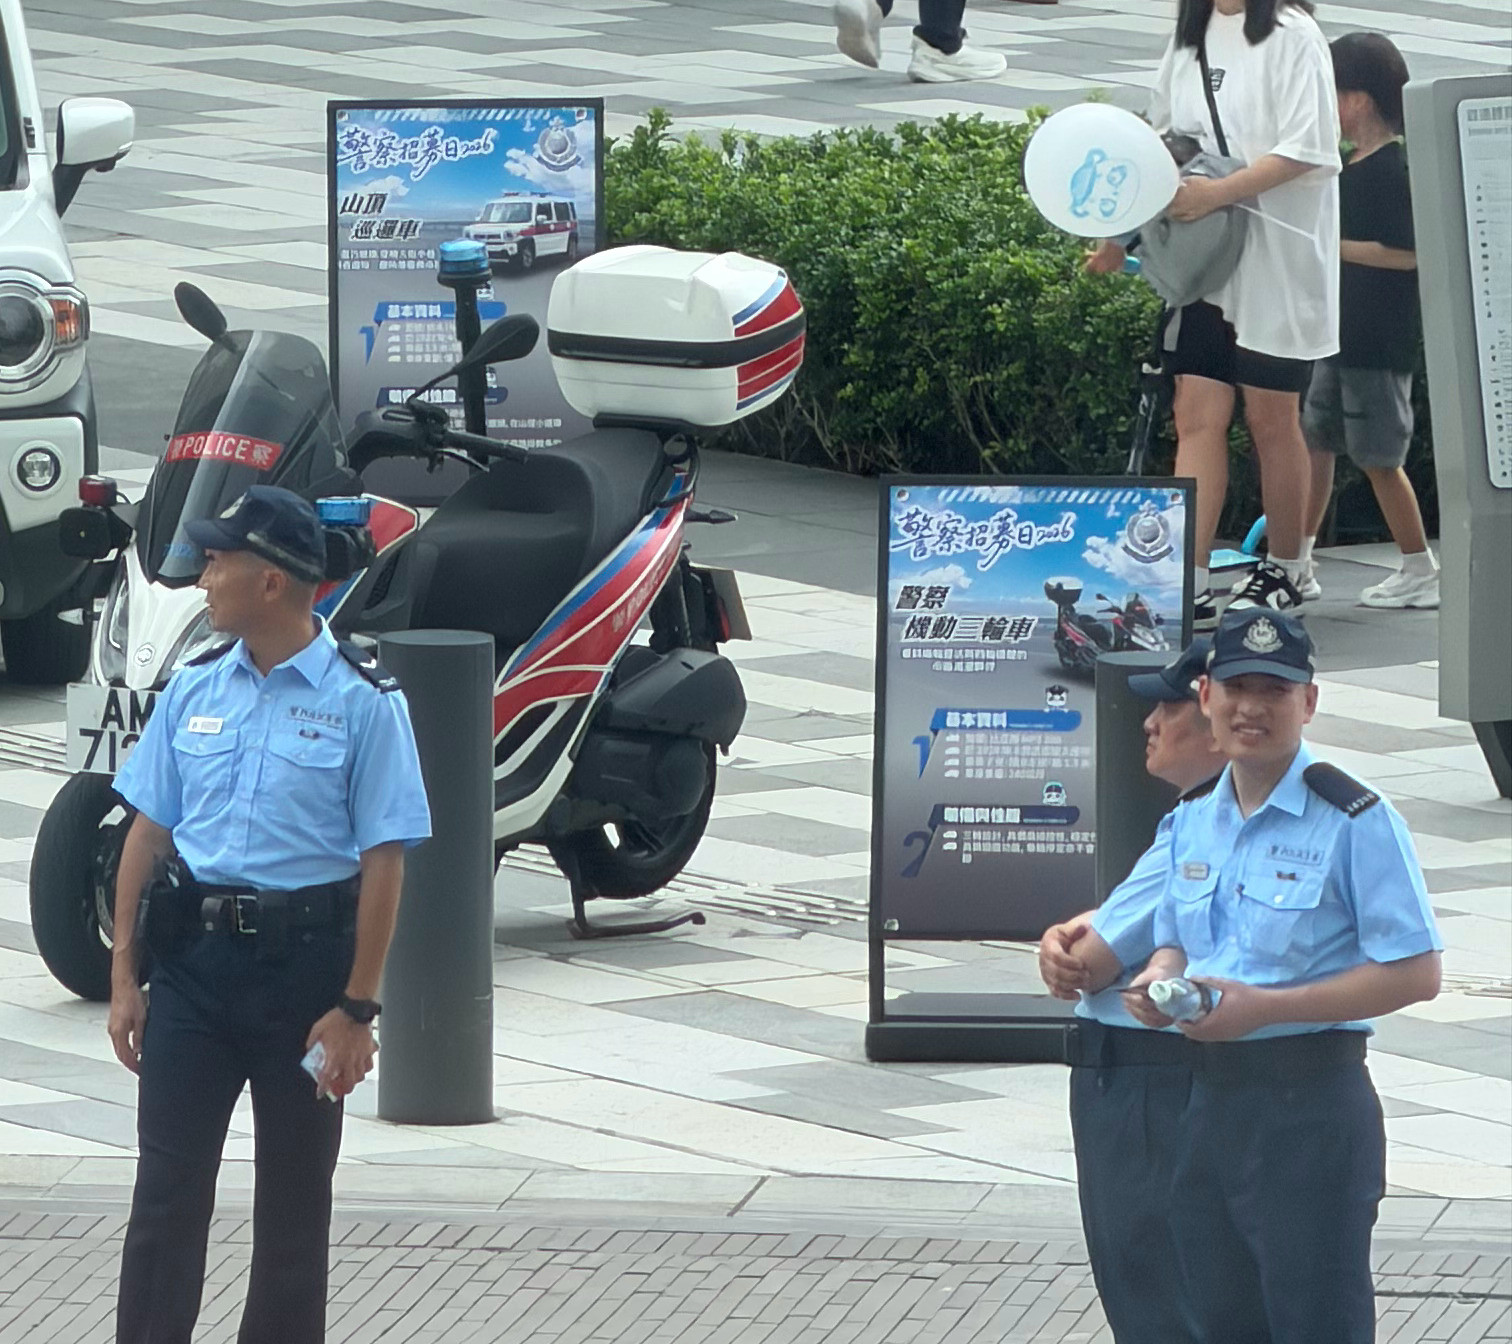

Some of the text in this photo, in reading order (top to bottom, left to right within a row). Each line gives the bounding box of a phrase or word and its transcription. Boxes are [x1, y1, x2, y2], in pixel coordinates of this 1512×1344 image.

[340, 192, 389, 216] 山頂
[181, 435, 251, 460] POLICE
[896, 585, 951, 610] 警察
[904, 614, 1036, 641] 機動三輪車
